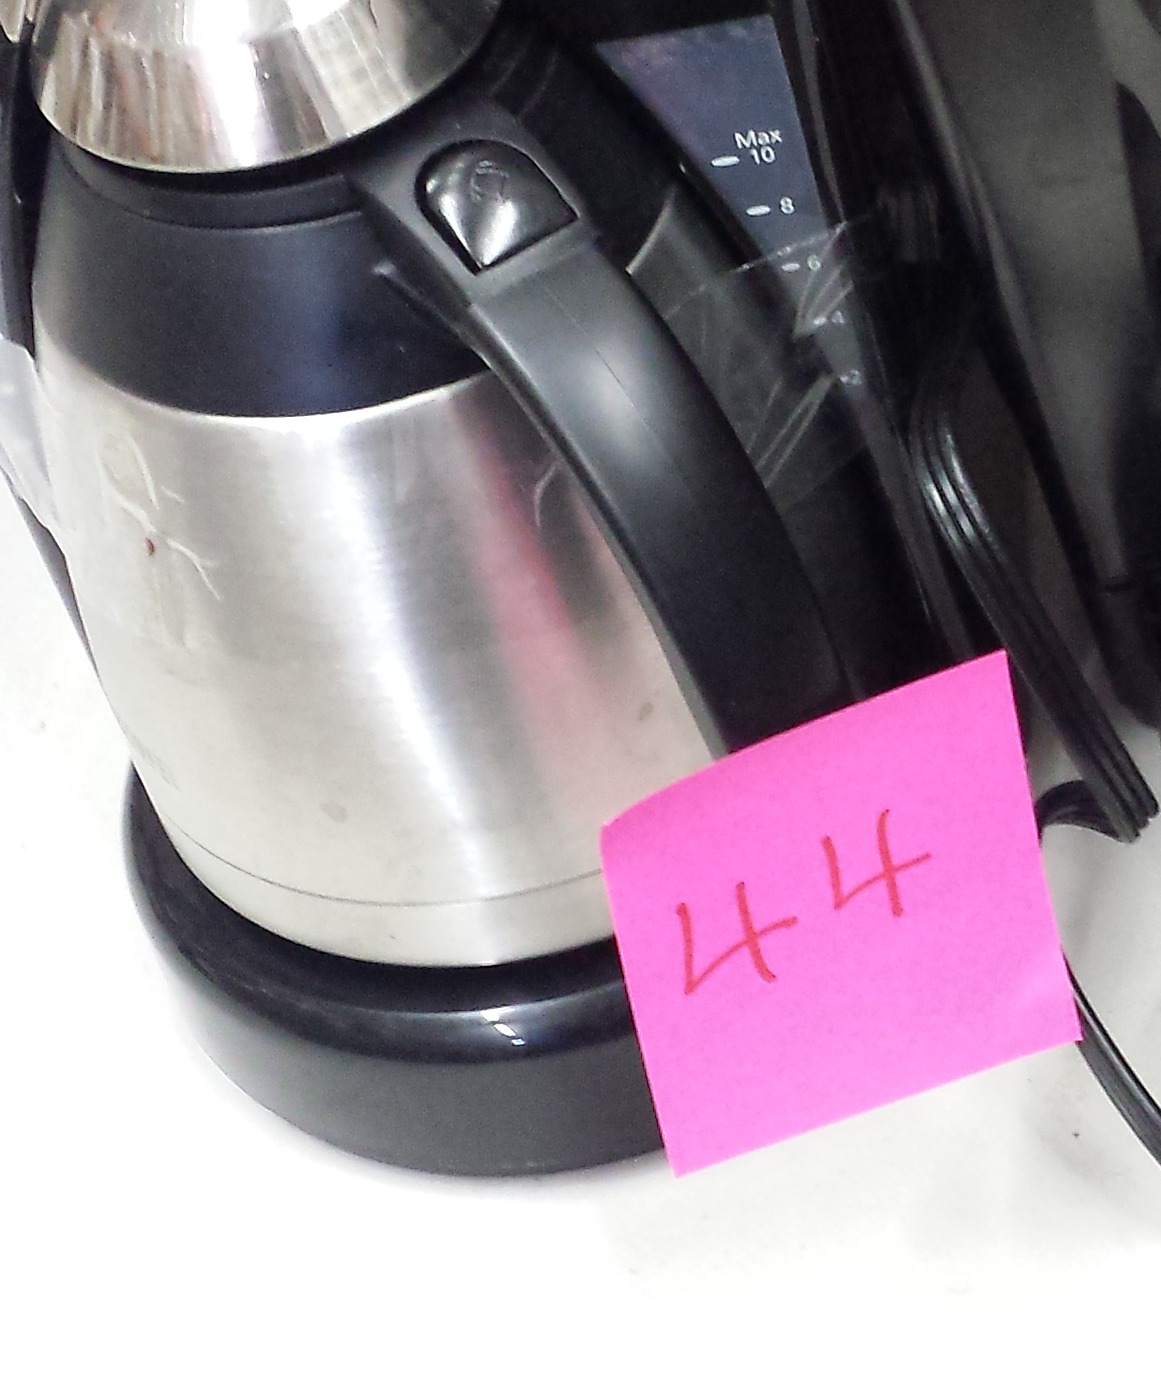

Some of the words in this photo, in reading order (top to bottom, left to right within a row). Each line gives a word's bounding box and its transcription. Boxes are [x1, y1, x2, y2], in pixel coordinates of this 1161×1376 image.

[734, 129, 783, 149] Max
[749, 145, 777, 165] 10
[779, 196, 796, 215] 8
[807, 254, 822, 272] 6
